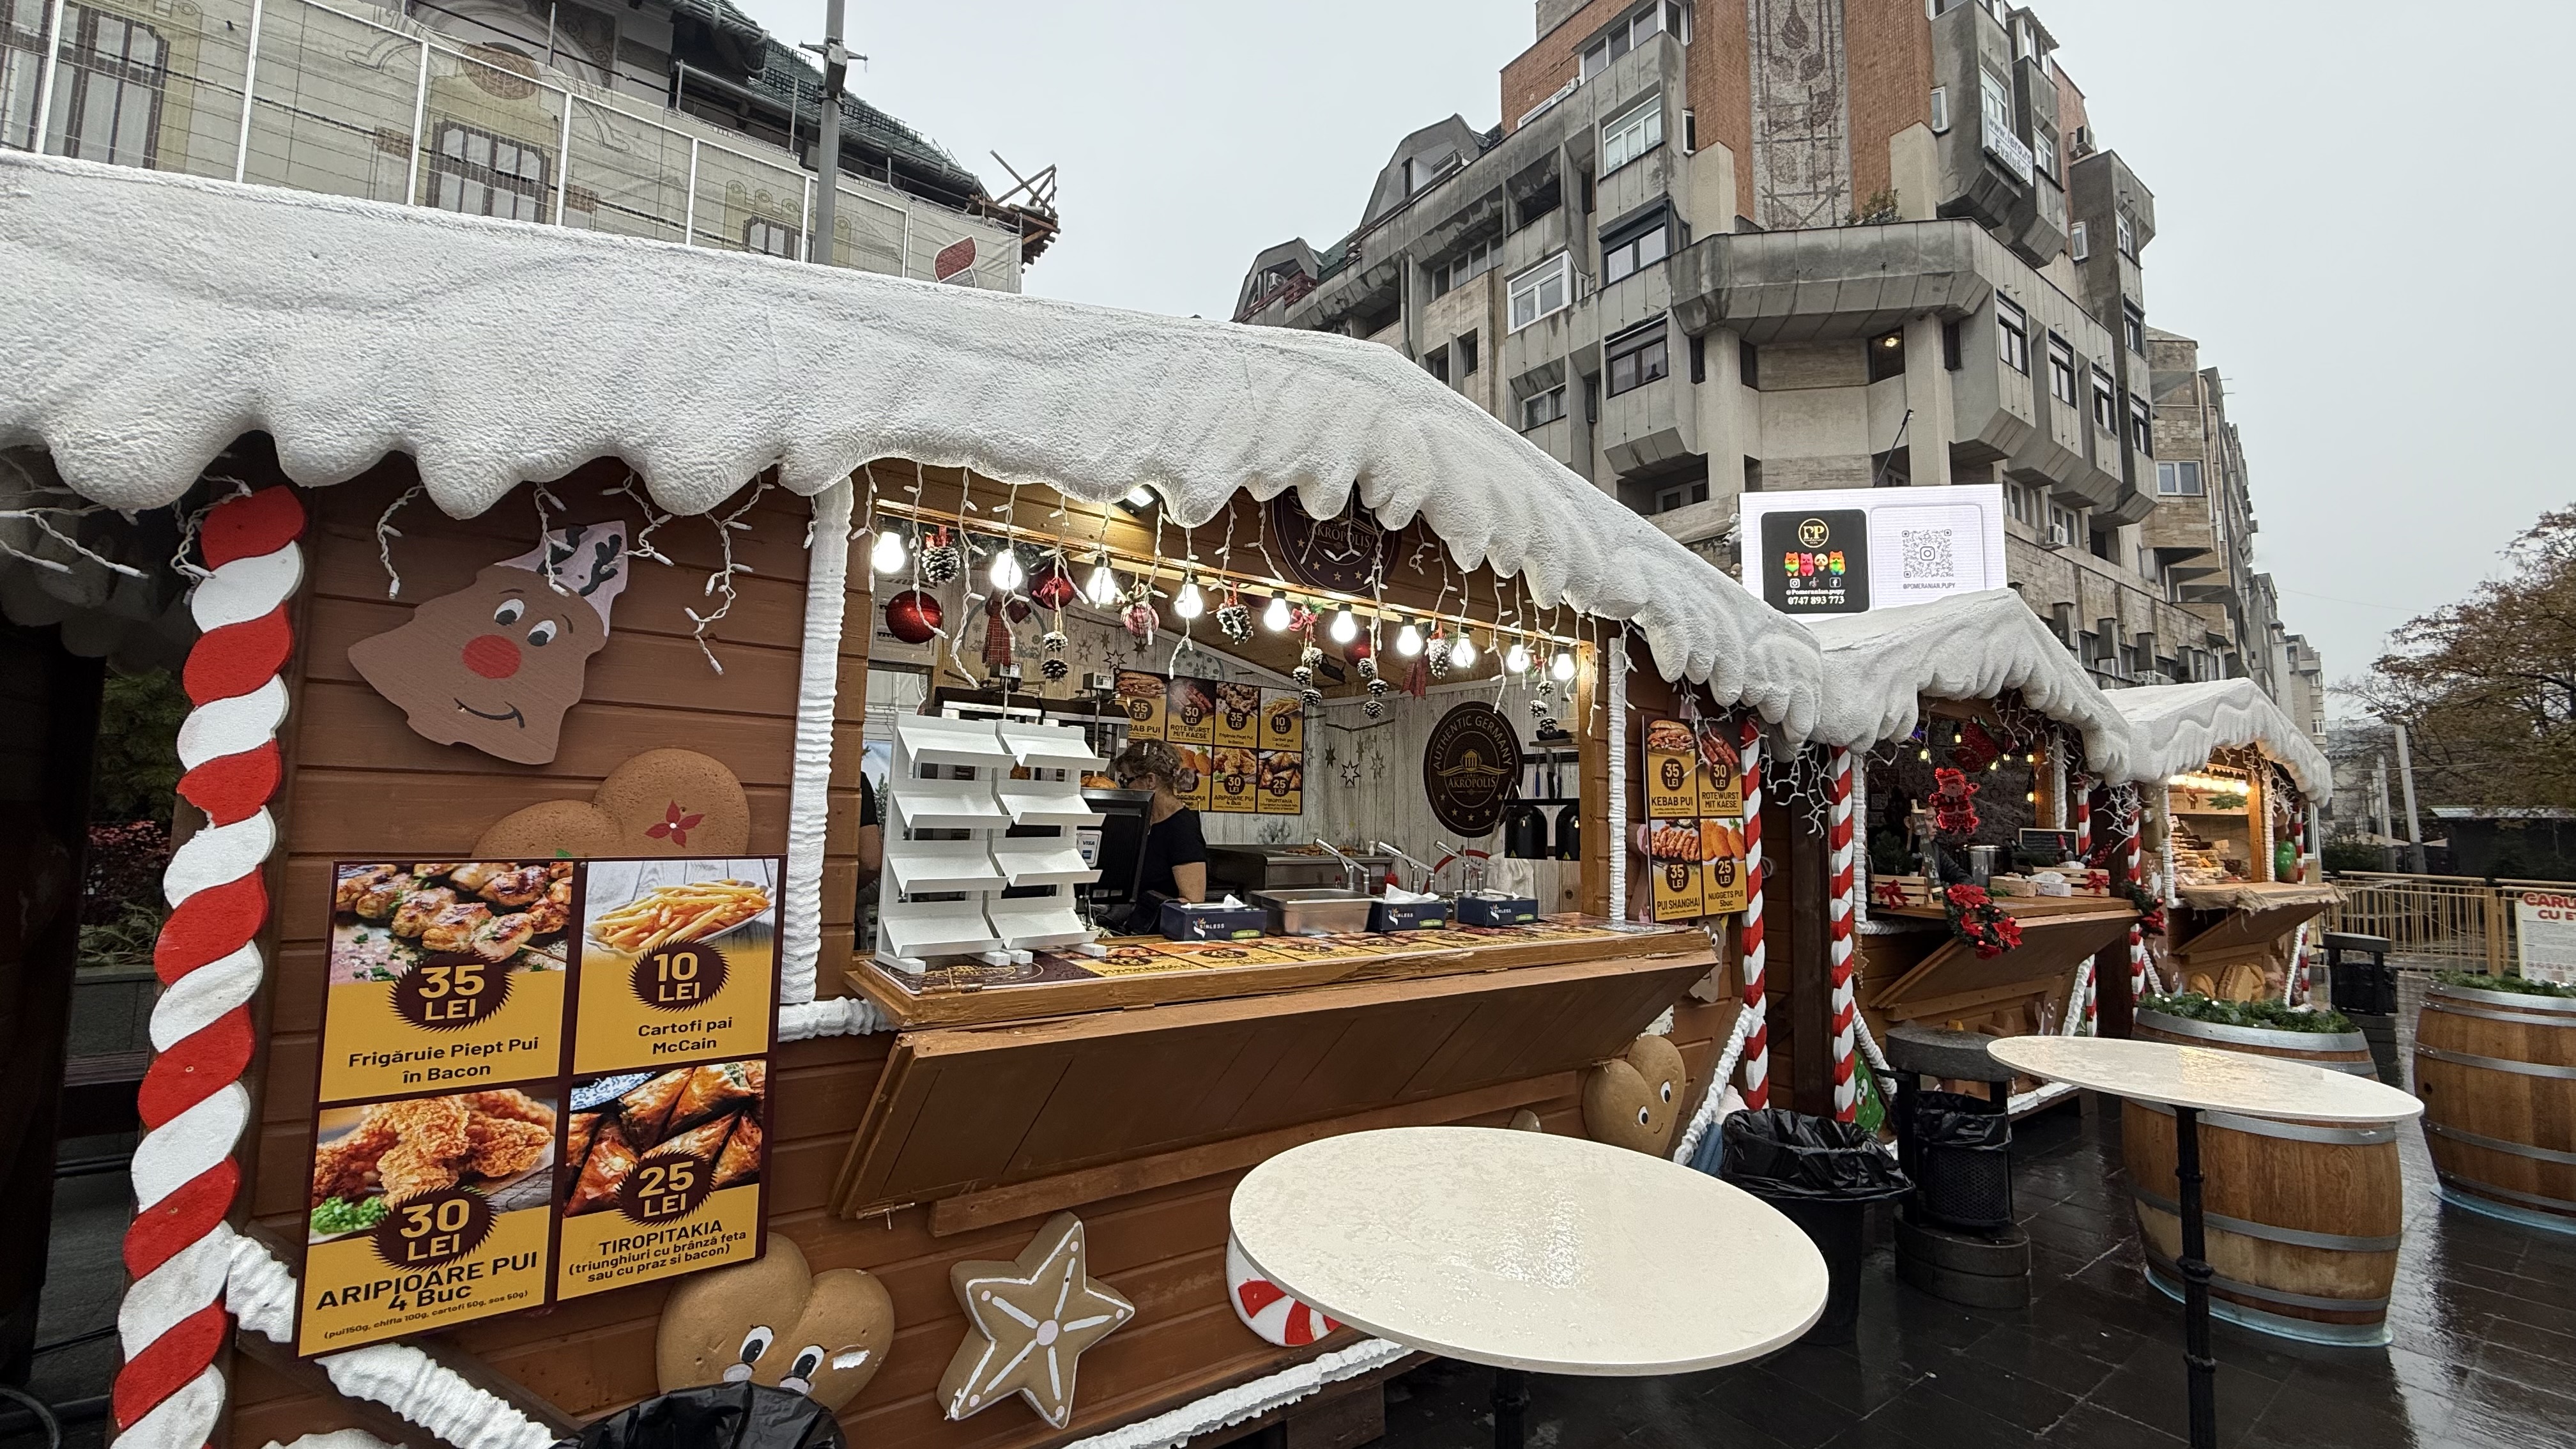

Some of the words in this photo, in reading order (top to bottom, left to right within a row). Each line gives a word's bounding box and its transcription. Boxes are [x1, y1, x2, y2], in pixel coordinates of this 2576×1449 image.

[1811, 596, 1827, 604] 893
[1133, 703, 1148, 712] 35
[1185, 707, 1199, 717] 30
[1230, 712, 1243, 722] 35
[1275, 717, 1285, 726] 10
[1128, 724, 1145, 732] BAB
[1433, 716, 1471, 769] AUTHENTIC
[1475, 716, 1512, 765] GERMANY
[1666, 763, 1679, 778] 35
[1713, 764, 1726, 778] 30
[1228, 777, 1241, 786] 30
[1273, 779, 1286, 788] 25
[1448, 776, 1496, 788] AKROPOLIS
[1667, 778, 1678, 786] LEI
[1715, 779, 1725, 788] LEI
[1652, 796, 1679, 806] KEBAB
[1680, 796, 1693, 806] PUI
[1670, 864, 1685, 878] 35
[1718, 860, 1731, 874] 25
[1673, 879, 1683, 888] LEI
[1720, 875, 1731, 884] LEI
[1708, 891, 1733, 900] NUGGETS
[1657, 900, 1667, 911] PUI
[1669, 897, 1700, 909] SHANGHAI
[2538, 910, 2560, 919] CU
[654, 952, 698, 982] 10
[418, 964, 484, 999] 35
[658, 982, 700, 1002] LEI
[425, 999, 476, 1021] LEI
[639, 1020, 702, 1037] Cartofi
[707, 1016, 732, 1032] pai
[349, 1046, 444, 1068] Frigăruie
[450, 1041, 503, 1057] Piept
[509, 1036, 539, 1052] Pui
[652, 1038, 717, 1055] McCain
[402, 1070, 421, 1084] în
[427, 1065, 491, 1082] Bacon
[639, 1161, 694, 1198] 25
[644, 1193, 686, 1217] LEI
[400, 1199, 470, 1238] 30
[599, 1220, 722, 1256] TIROPITAKIA
[408, 1233, 460, 1262] LEI
[569, 1248, 650, 1276] (triunghiuri
[654, 1248, 670, 1259] cu
[673, 1236, 717, 1254] brânză
[721, 1231, 746, 1245] feta
[588, 1269, 613, 1282] sau
[617, 1266, 634, 1276] cu
[636, 1259, 666, 1274] praz
[670, 1253, 682, 1264] si
[684, 1243, 730, 1262] bacon)
[316, 1261, 485, 1311] ARIPIOARE
[492, 1251, 537, 1276] PUI
[388, 1294, 407, 1311] 4
[417, 1285, 472, 1308] Buc
[431, 1303, 464, 1315] cartofi
